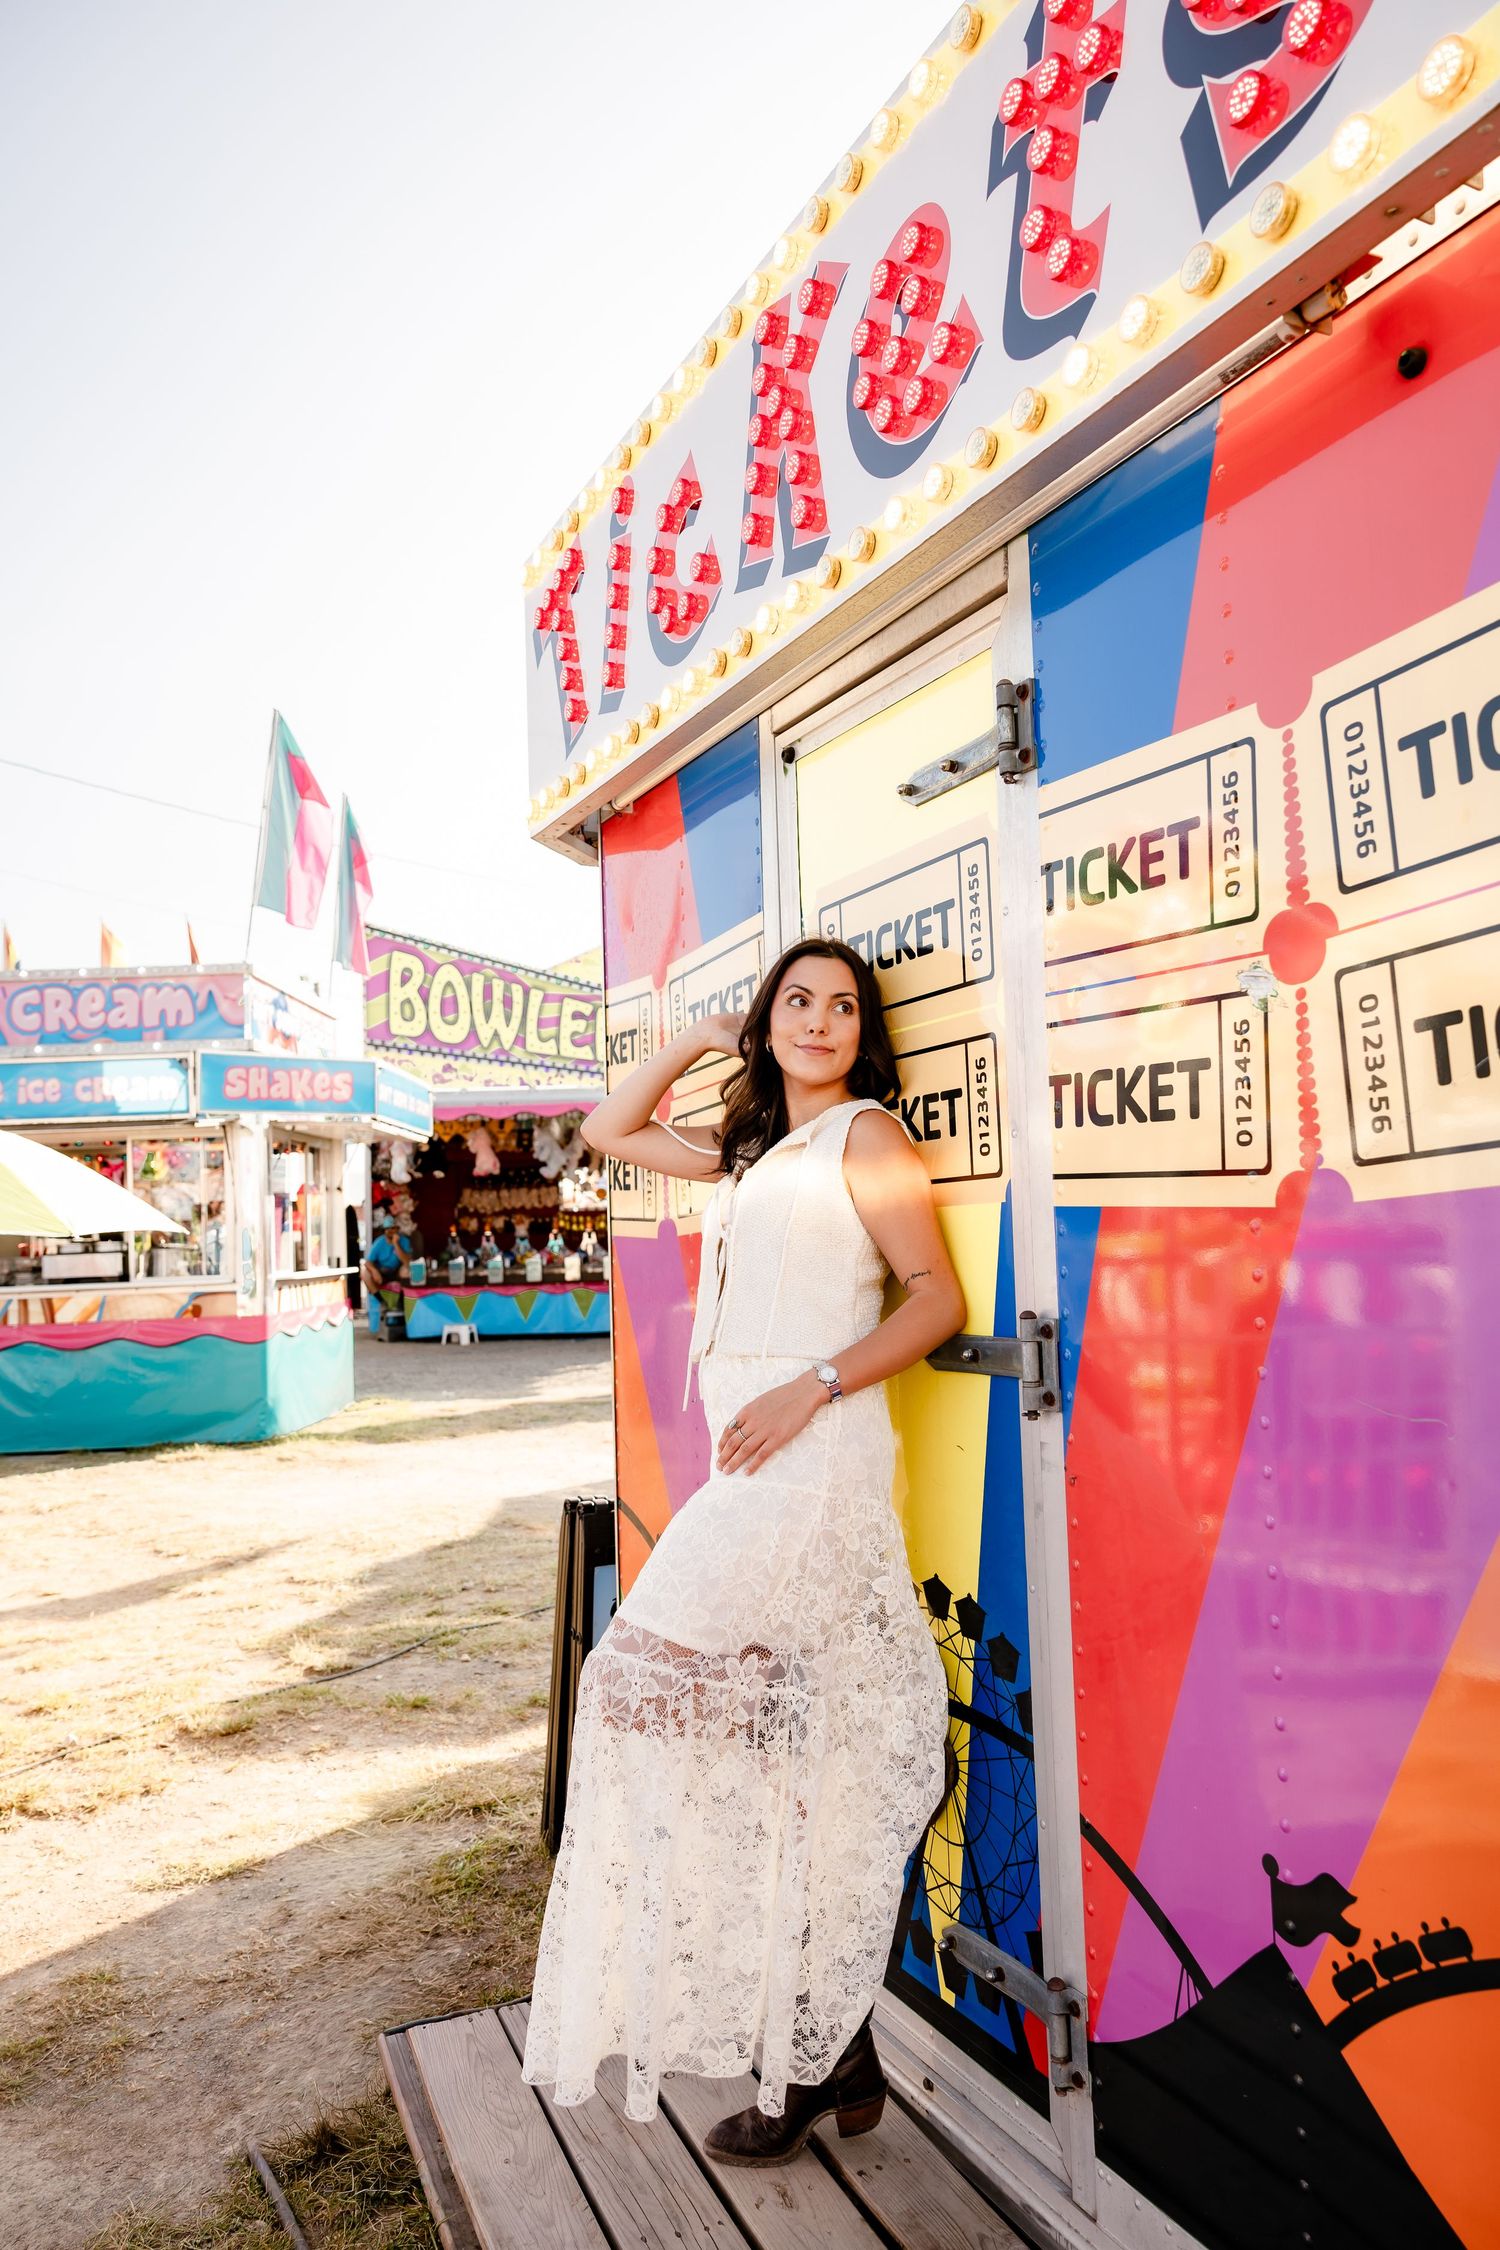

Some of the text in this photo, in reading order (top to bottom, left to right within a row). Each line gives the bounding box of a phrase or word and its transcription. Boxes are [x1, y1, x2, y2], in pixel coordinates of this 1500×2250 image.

[1222, 769, 1241, 898] 0123456
[1343, 721, 1377, 859] 0123456
[967, 862, 983, 963] 0123456
[1040, 815, 1201, 917] TICKET
[846, 897, 956, 974] TICKET
[388, 950, 603, 1063] BOWLE
[607, 1028, 638, 1067] KET
[1412, 1004, 1500, 1087] TI
[974, 1056, 991, 1157] 0123456
[1048, 1056, 1212, 1129] TICKET
[1233, 1018, 1253, 1147] 0123456
[1358, 993, 1392, 1134] 0123456
